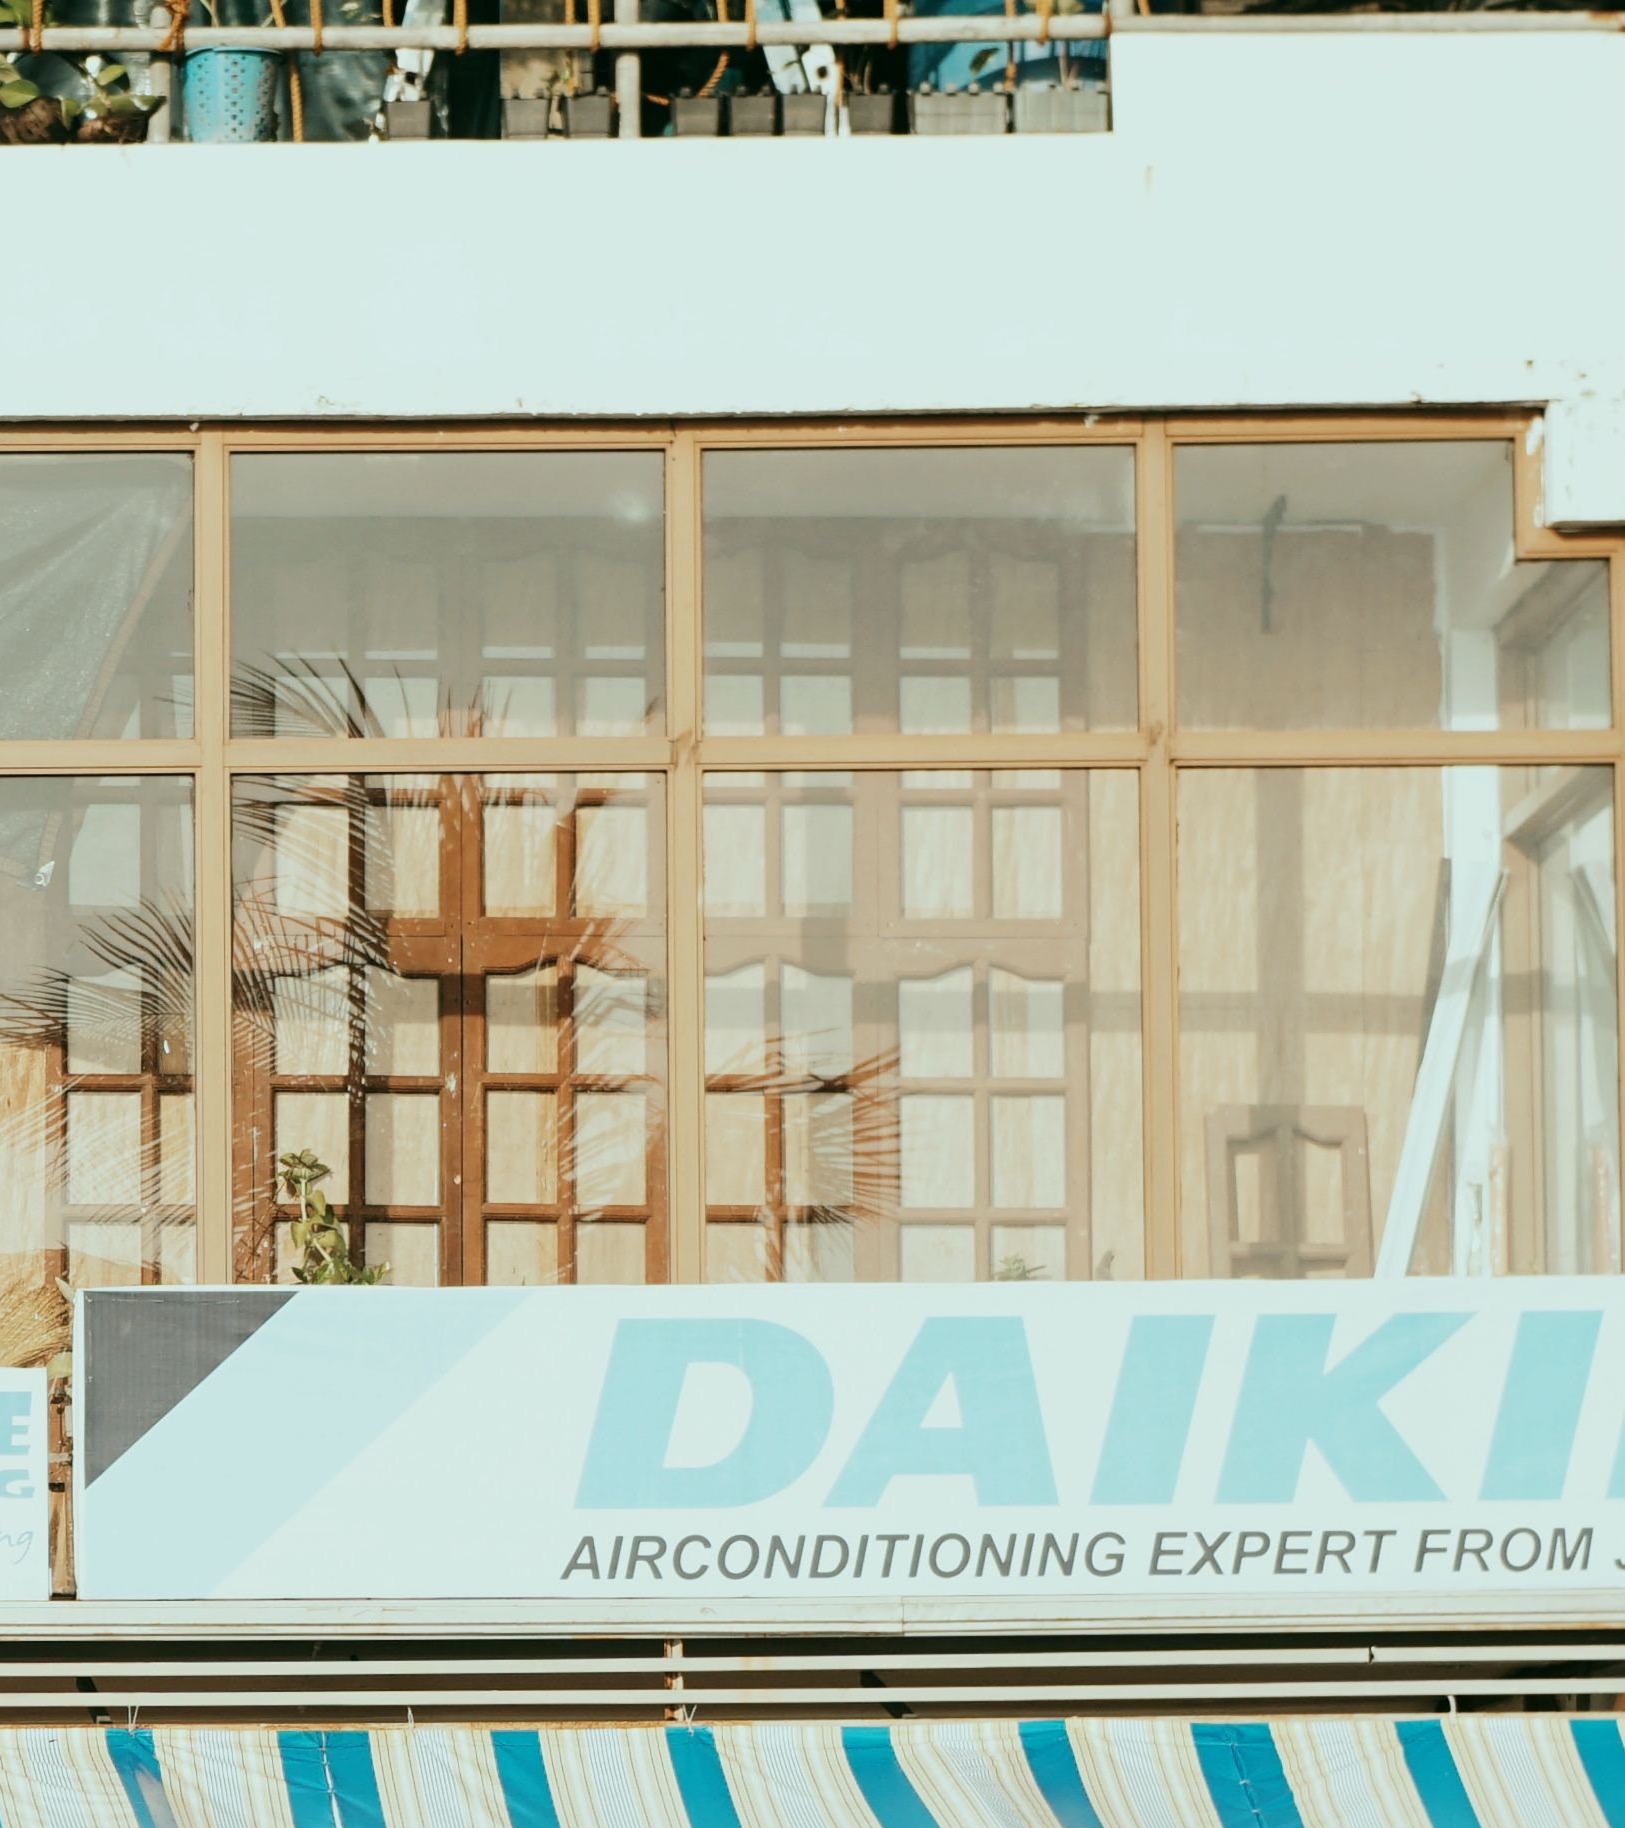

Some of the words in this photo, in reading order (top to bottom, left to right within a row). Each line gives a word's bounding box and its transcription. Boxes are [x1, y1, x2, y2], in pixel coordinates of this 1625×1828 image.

[573, 1310, 1625, 1510] DAIKI
[560, 1531, 1127, 1581] AIRCONDITIONING
[1148, 1529, 1398, 1577] EXPERT
[1413, 1527, 1594, 1574] FROM
